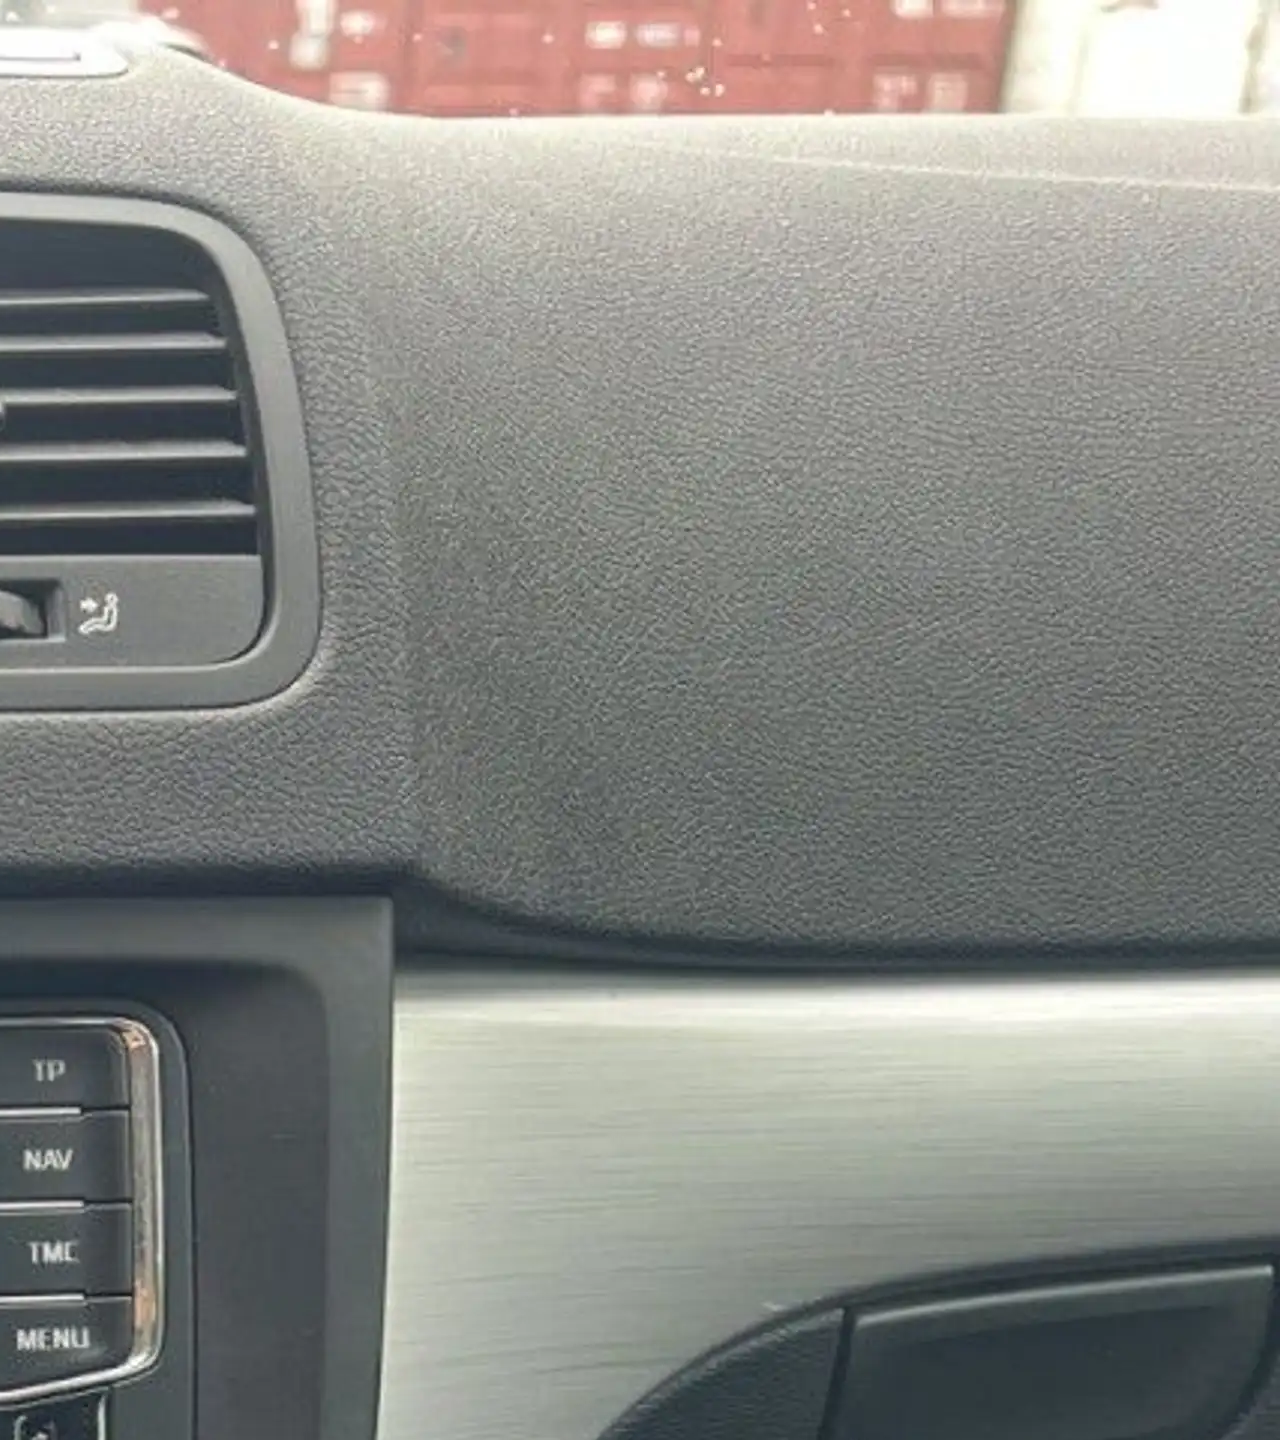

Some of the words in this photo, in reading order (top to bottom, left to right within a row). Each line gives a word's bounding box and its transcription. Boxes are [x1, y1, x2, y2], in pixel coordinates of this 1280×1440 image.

[32, 1059, 66, 1082] TP
[23, 1148, 74, 1171] NAV
[29, 1239, 80, 1264] TMC
[16, 1326, 91, 1351] MENU
